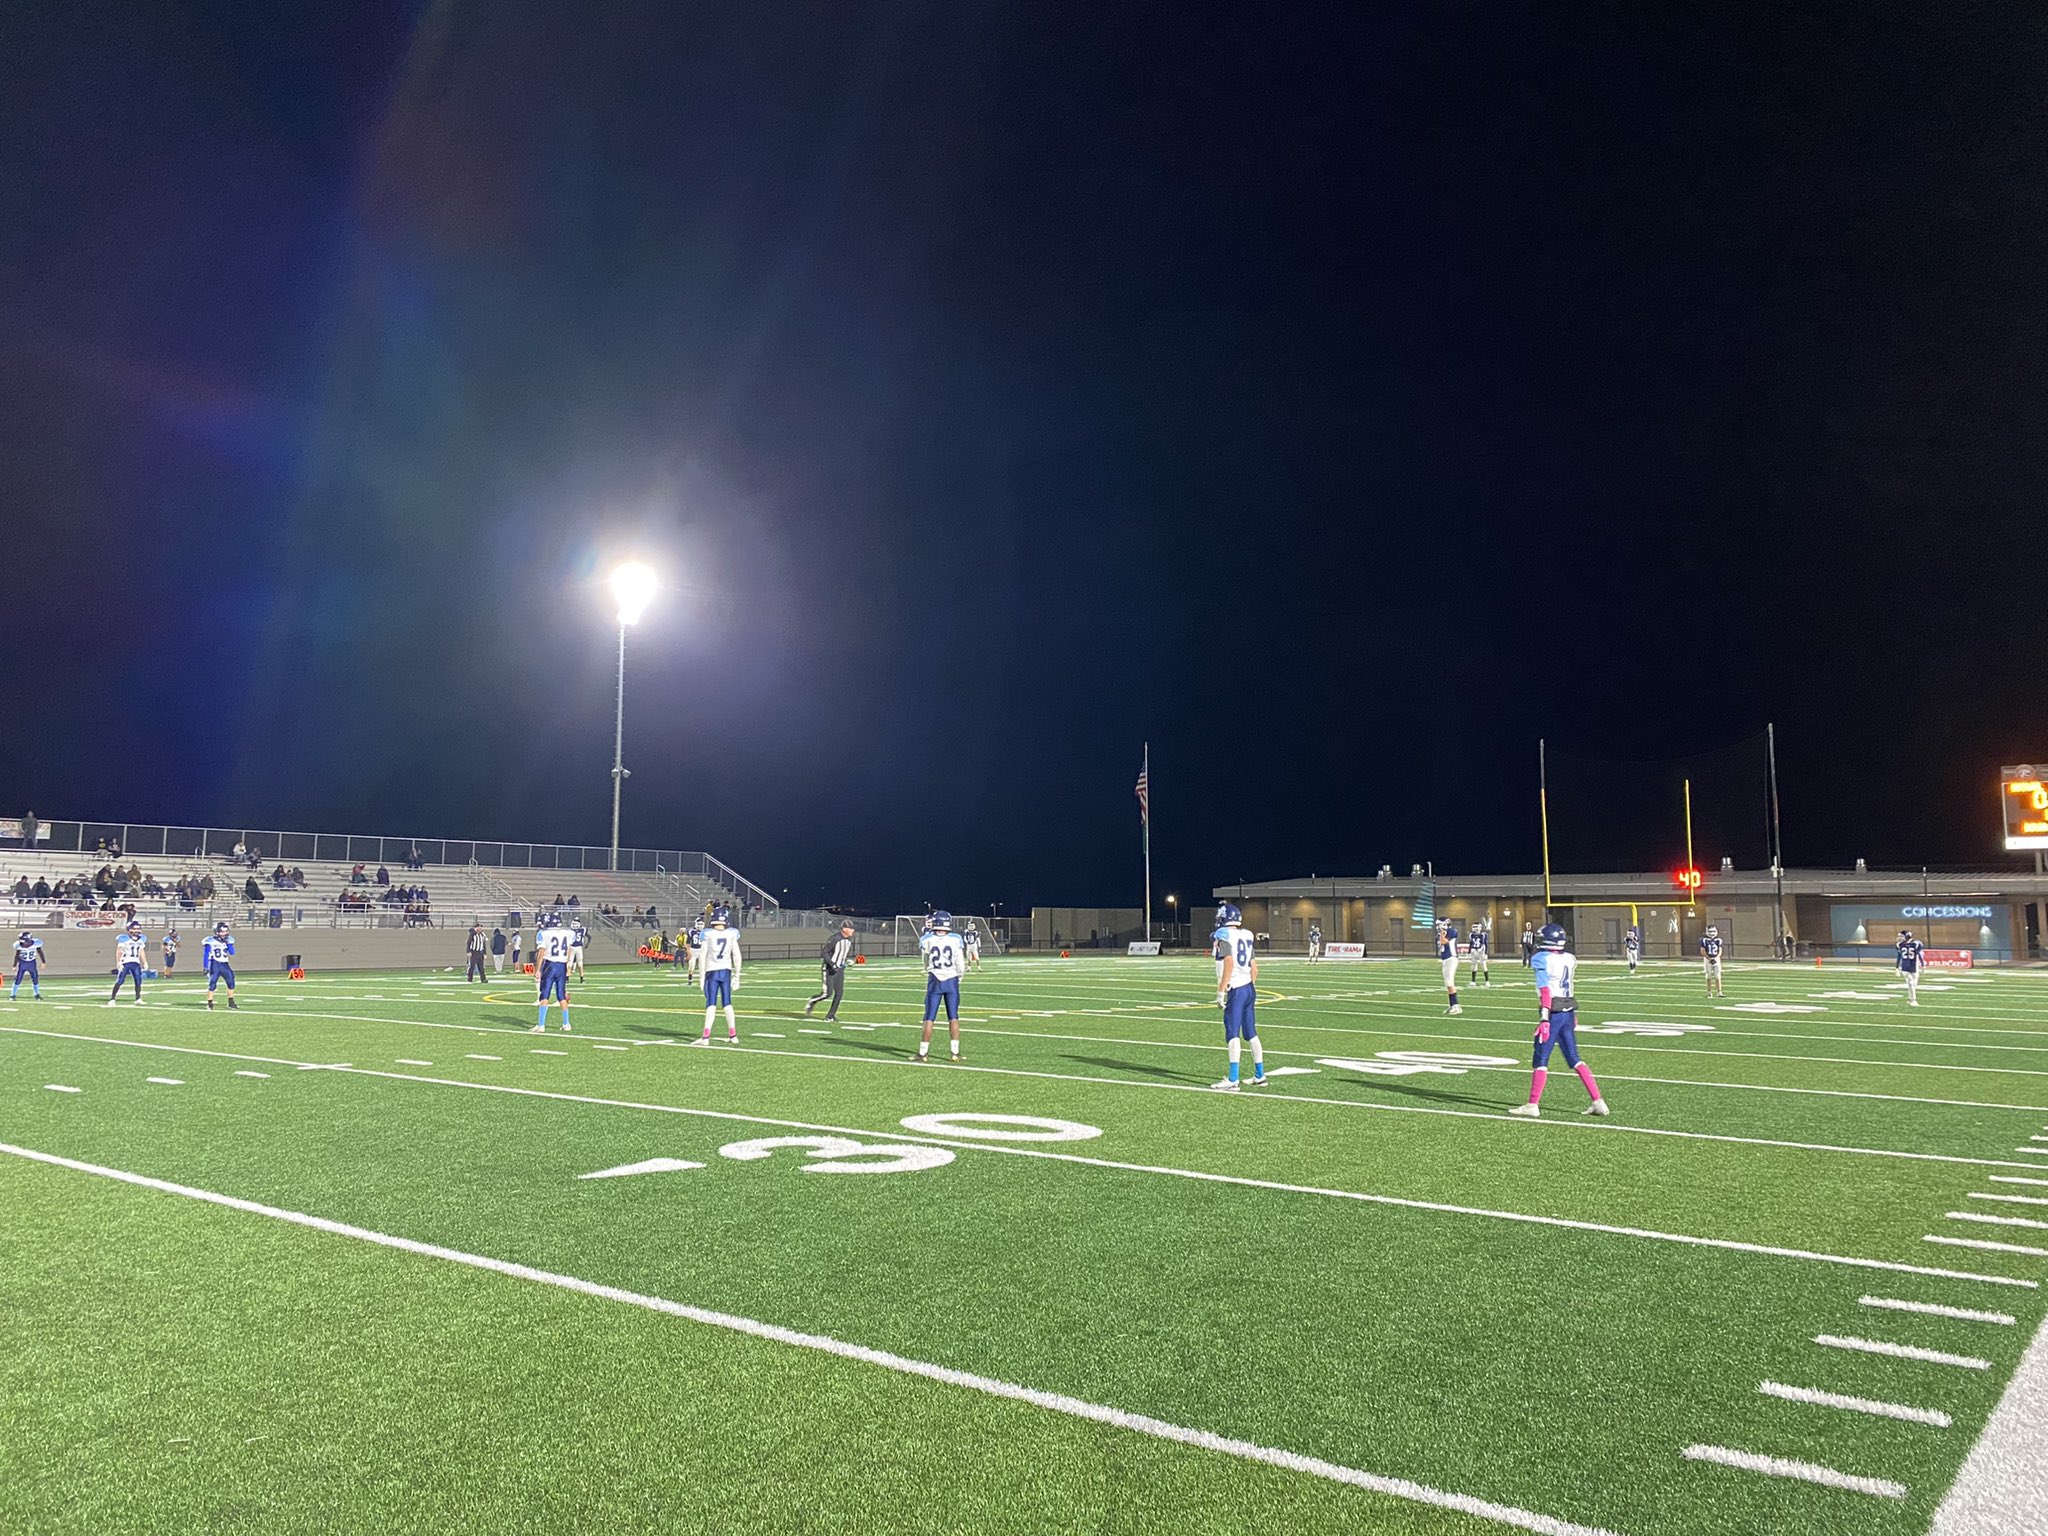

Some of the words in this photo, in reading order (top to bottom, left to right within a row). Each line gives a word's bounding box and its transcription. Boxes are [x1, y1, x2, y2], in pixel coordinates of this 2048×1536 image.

[1679, 872, 1701, 887] 40
[1903, 906, 1992, 918] CONCESSIONS
[130, 945, 140, 957] 11
[551, 936, 568, 956] 24
[717, 938, 727, 959] 7
[1707, 944, 1718, 956] 12
[21, 950, 35, 960] 28
[931, 945, 953, 969] 23
[1901, 947, 1915, 960] 25
[293, 968, 304, 979] 50
[1560, 965, 1571, 997] 4
[718, 1112, 1103, 1174] 30
